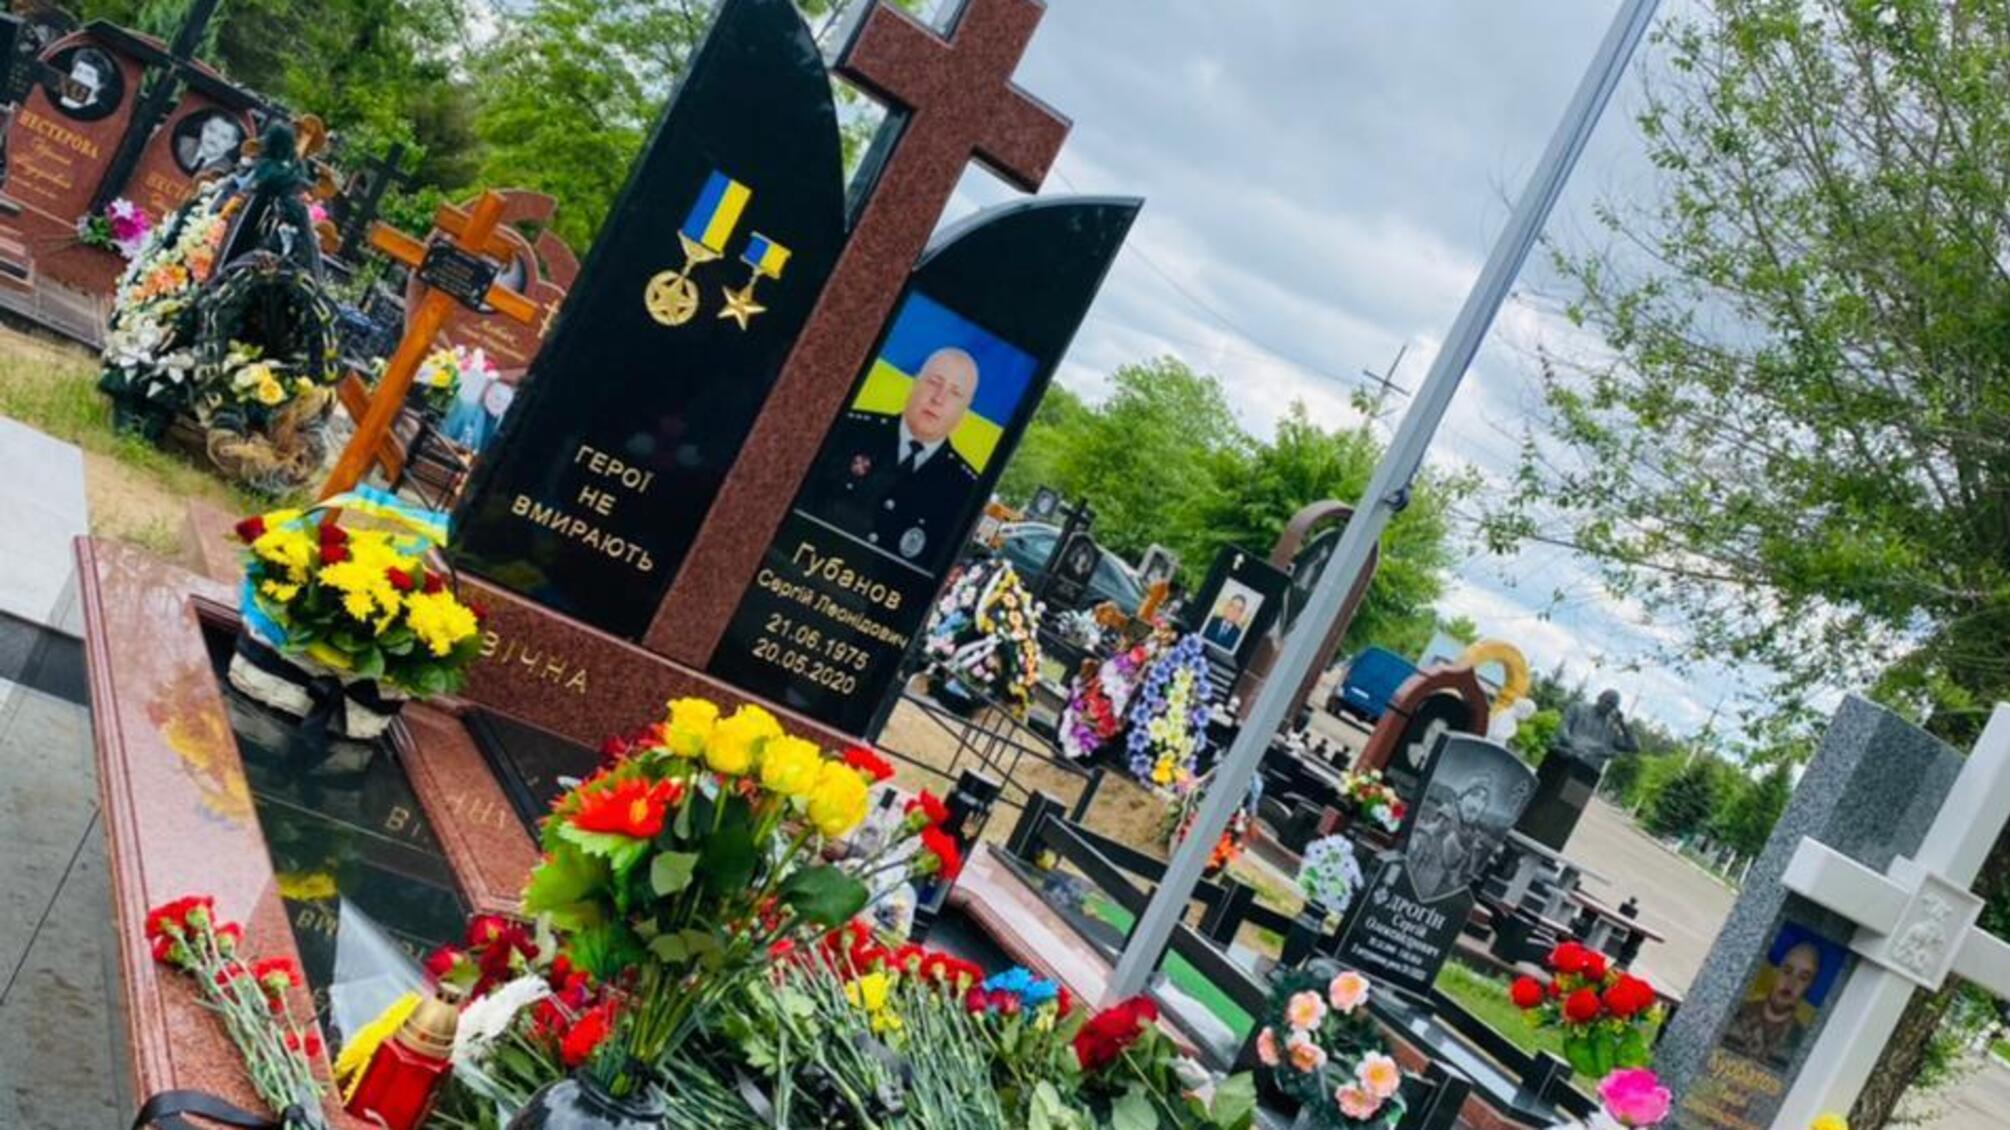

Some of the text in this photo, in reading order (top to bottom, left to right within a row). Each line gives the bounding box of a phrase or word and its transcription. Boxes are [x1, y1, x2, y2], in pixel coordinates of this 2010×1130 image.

[574, 445, 655, 493] ГЕРОЇ
[577, 485, 616, 516] НЕ
[511, 494, 654, 572] ВМИРАЮТЬ
[792, 542, 902, 610] Губанов
[757, 569, 910, 649] Сергій Леонідович
[479, 630, 590, 694] ВІЧНА
[752, 637, 856, 695] 20.05.2020
[765, 613, 870, 670] 21.06.1975
